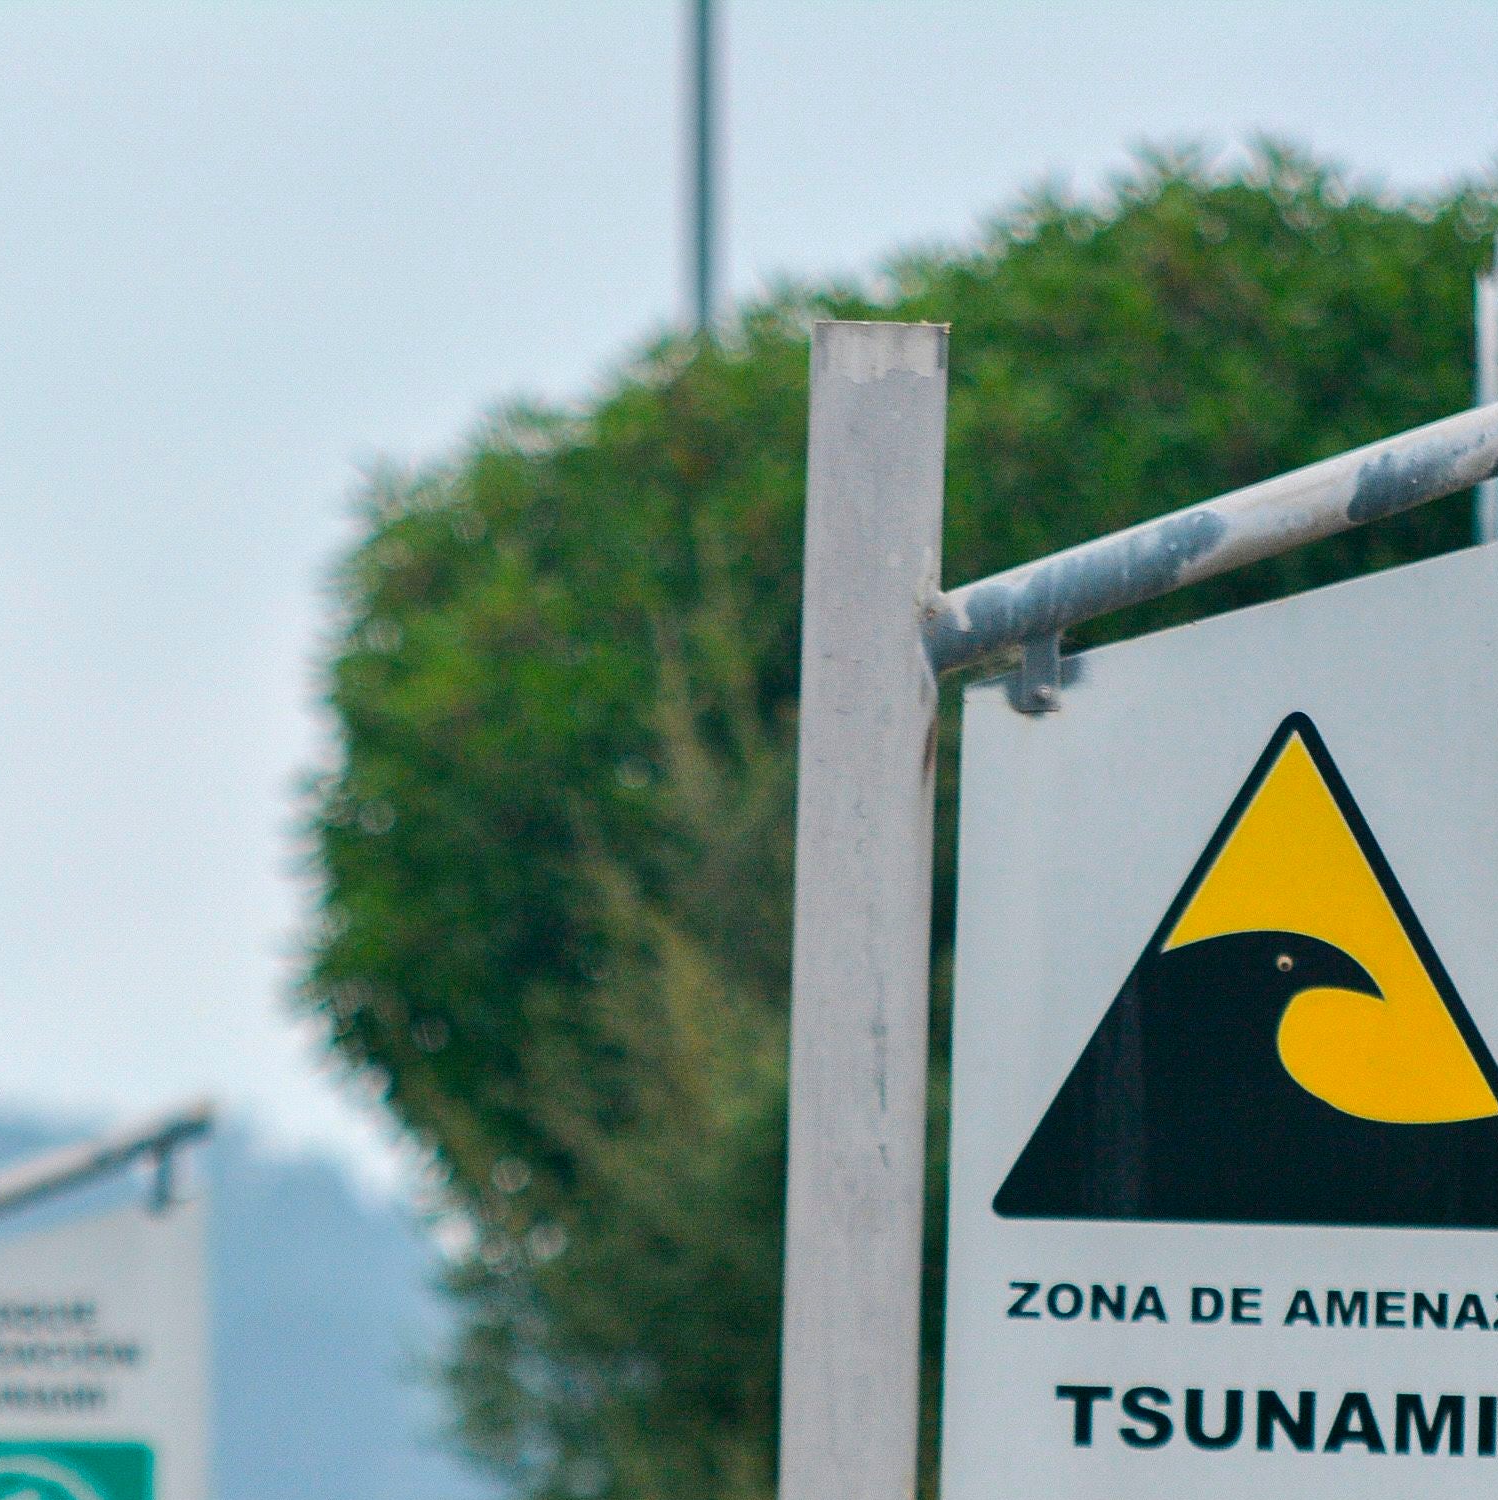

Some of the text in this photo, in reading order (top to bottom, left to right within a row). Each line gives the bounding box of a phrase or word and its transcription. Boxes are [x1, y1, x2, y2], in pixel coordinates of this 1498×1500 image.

[1005, 1280, 1168, 1324] ZONA
[1189, 1285, 1263, 1326] DE
[1054, 1383, 1498, 1458] TSUNAMI
